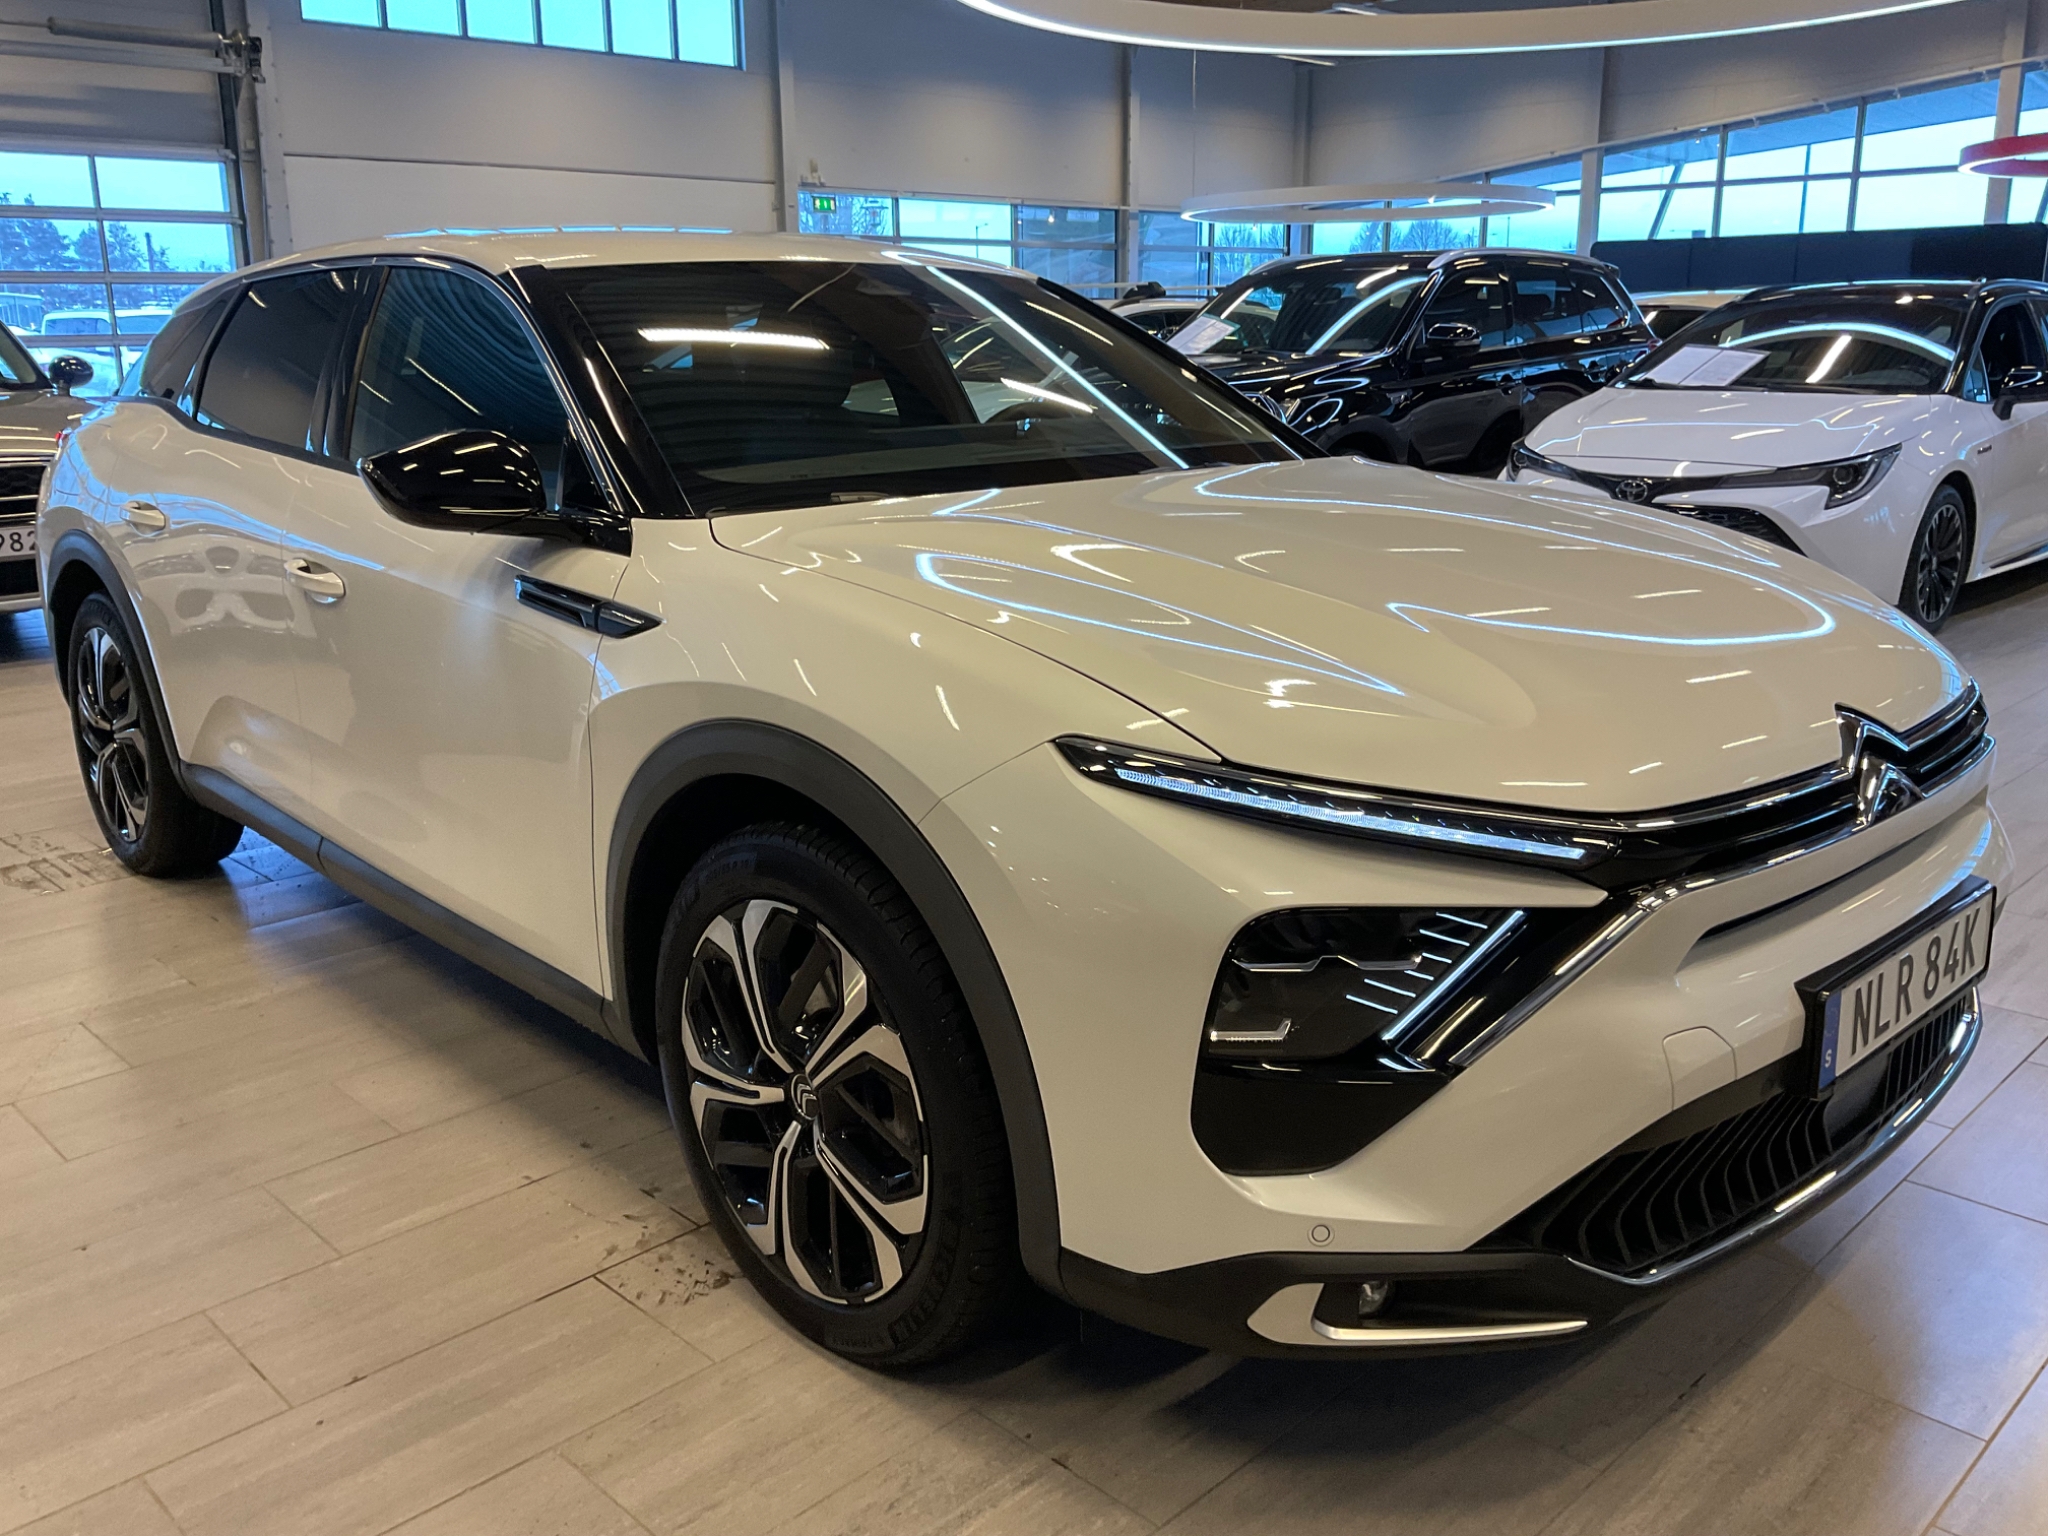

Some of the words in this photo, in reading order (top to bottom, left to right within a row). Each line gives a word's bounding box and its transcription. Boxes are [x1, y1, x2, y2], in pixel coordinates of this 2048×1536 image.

[1825, 1050, 1832, 1067] S
[1851, 953, 1914, 1056] NLR
[1923, 907, 1981, 1000] 84K
